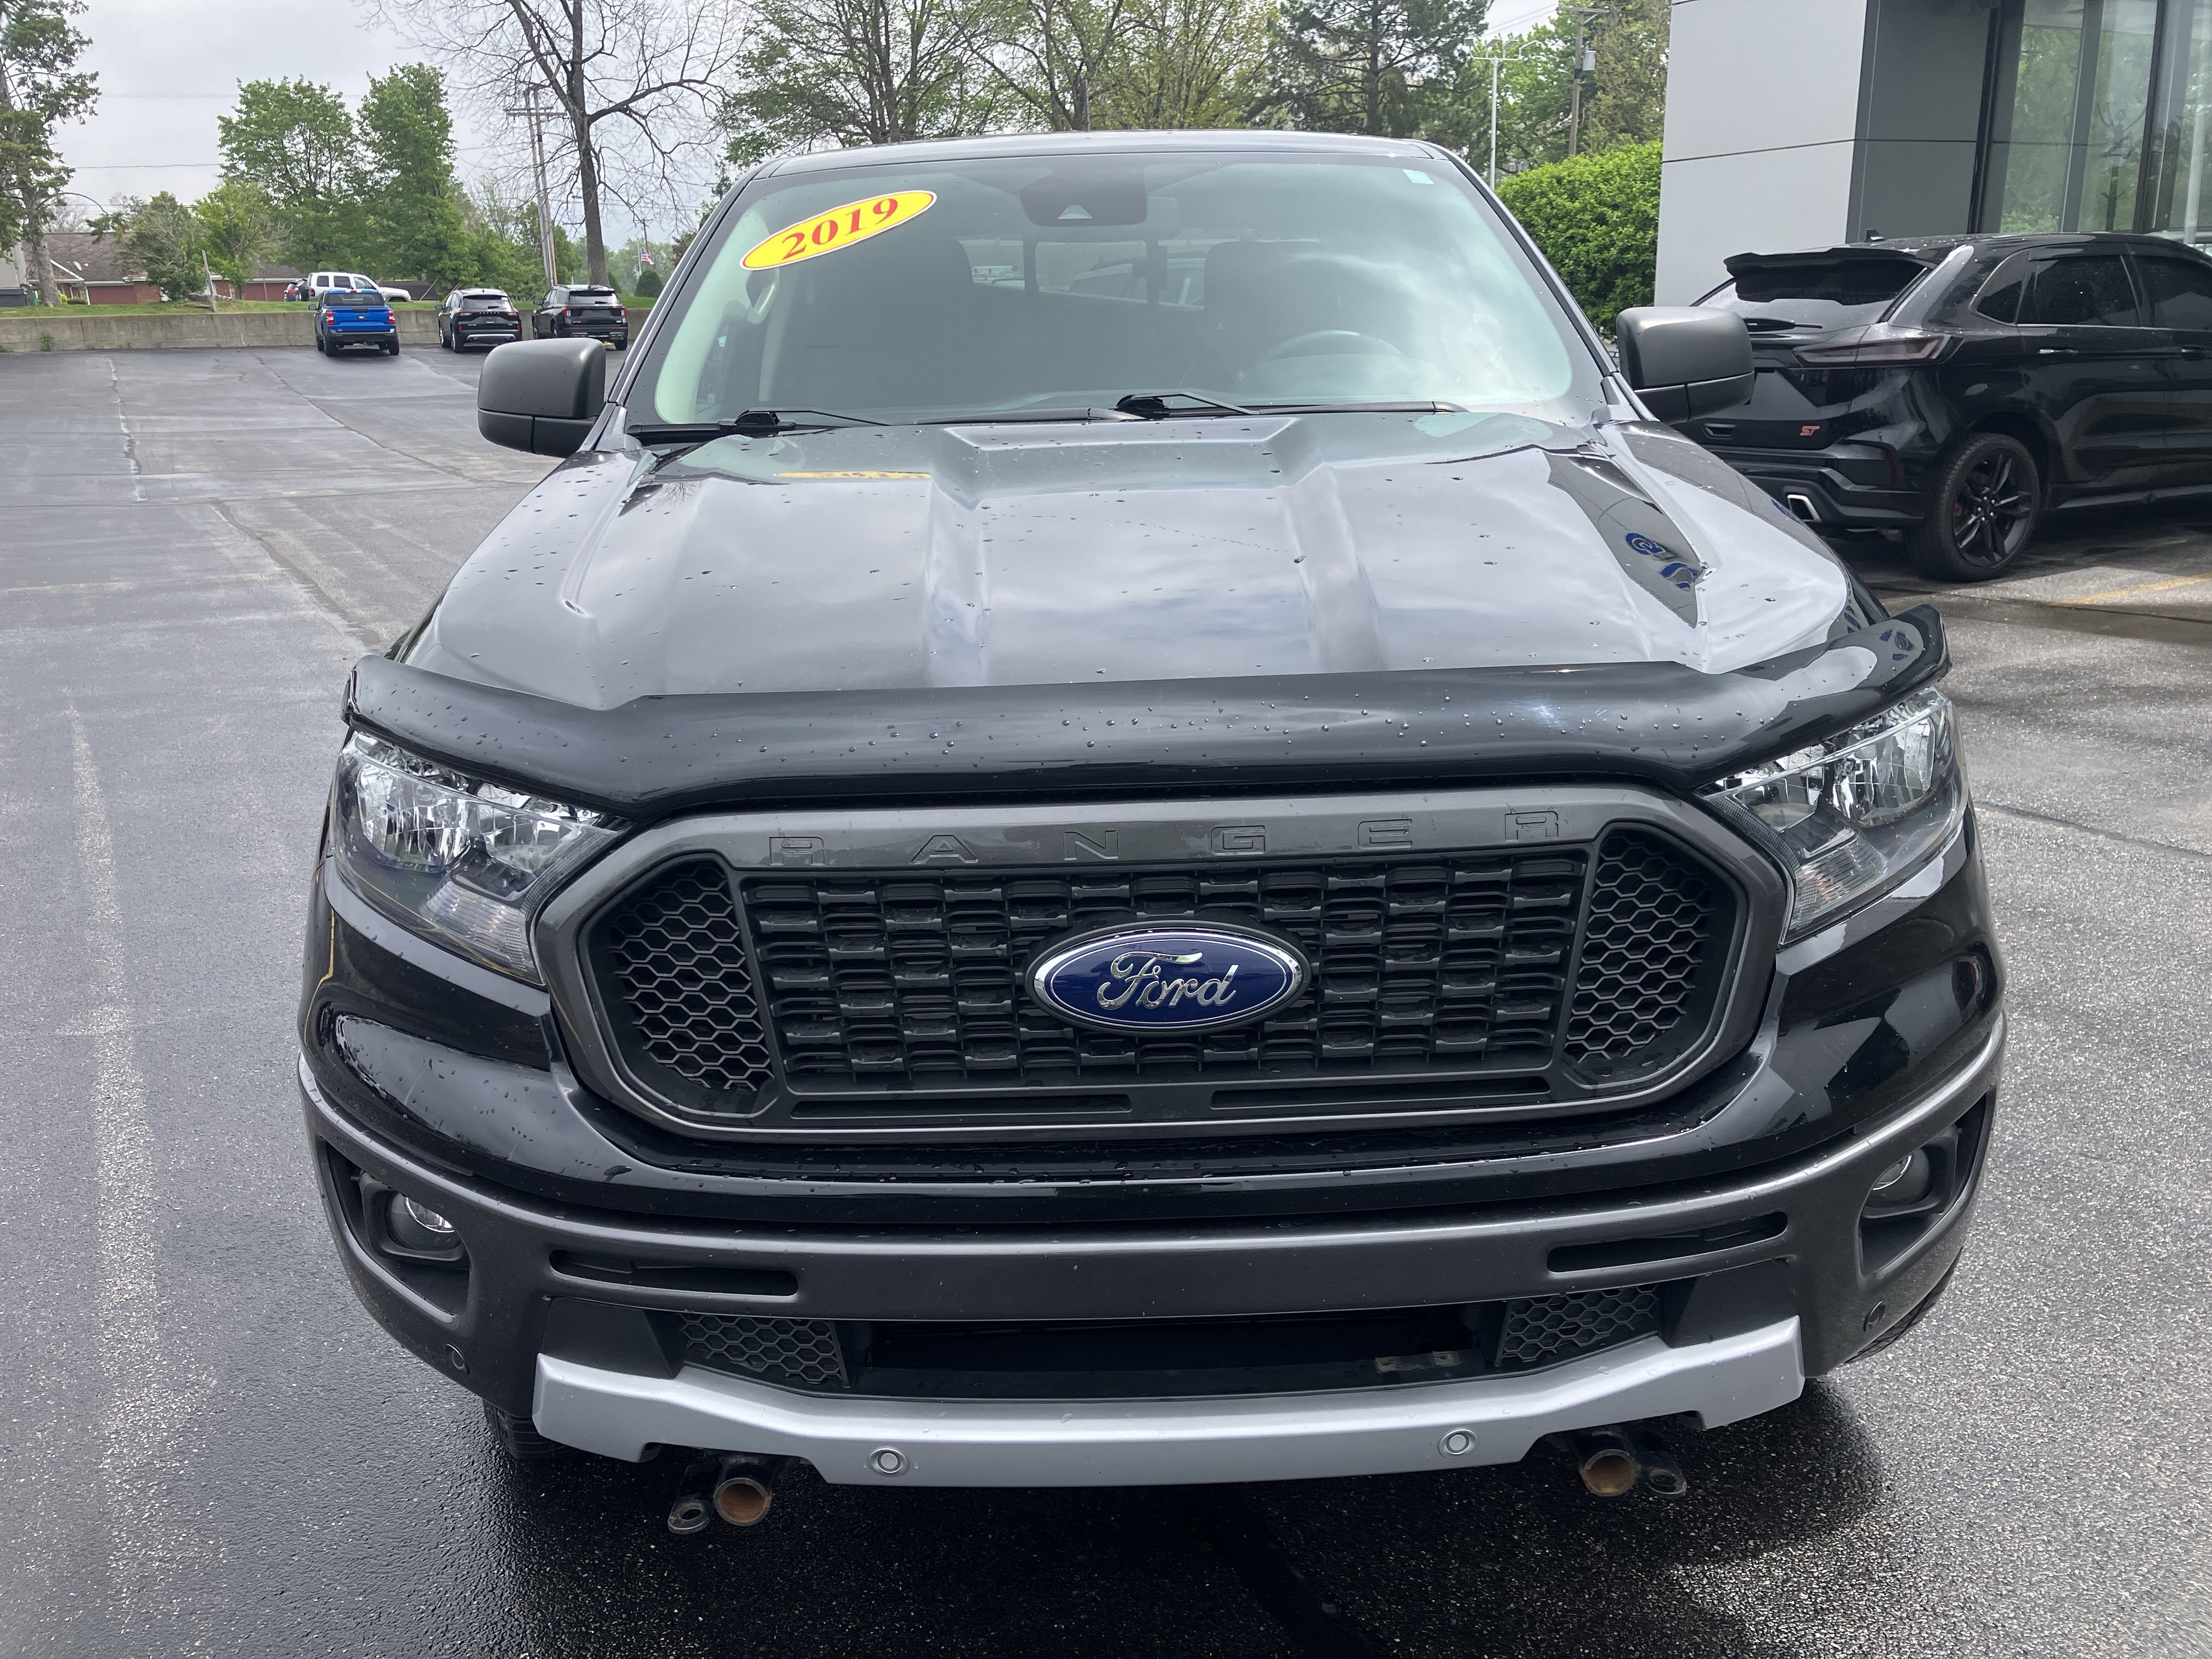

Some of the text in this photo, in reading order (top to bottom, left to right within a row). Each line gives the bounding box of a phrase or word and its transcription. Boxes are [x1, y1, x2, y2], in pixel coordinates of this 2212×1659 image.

[782, 198, 898, 261] 2019
[1799, 426, 1820, 436] ST
[769, 810, 1559, 866] RANGER
[1097, 951, 1239, 1010] Ford
